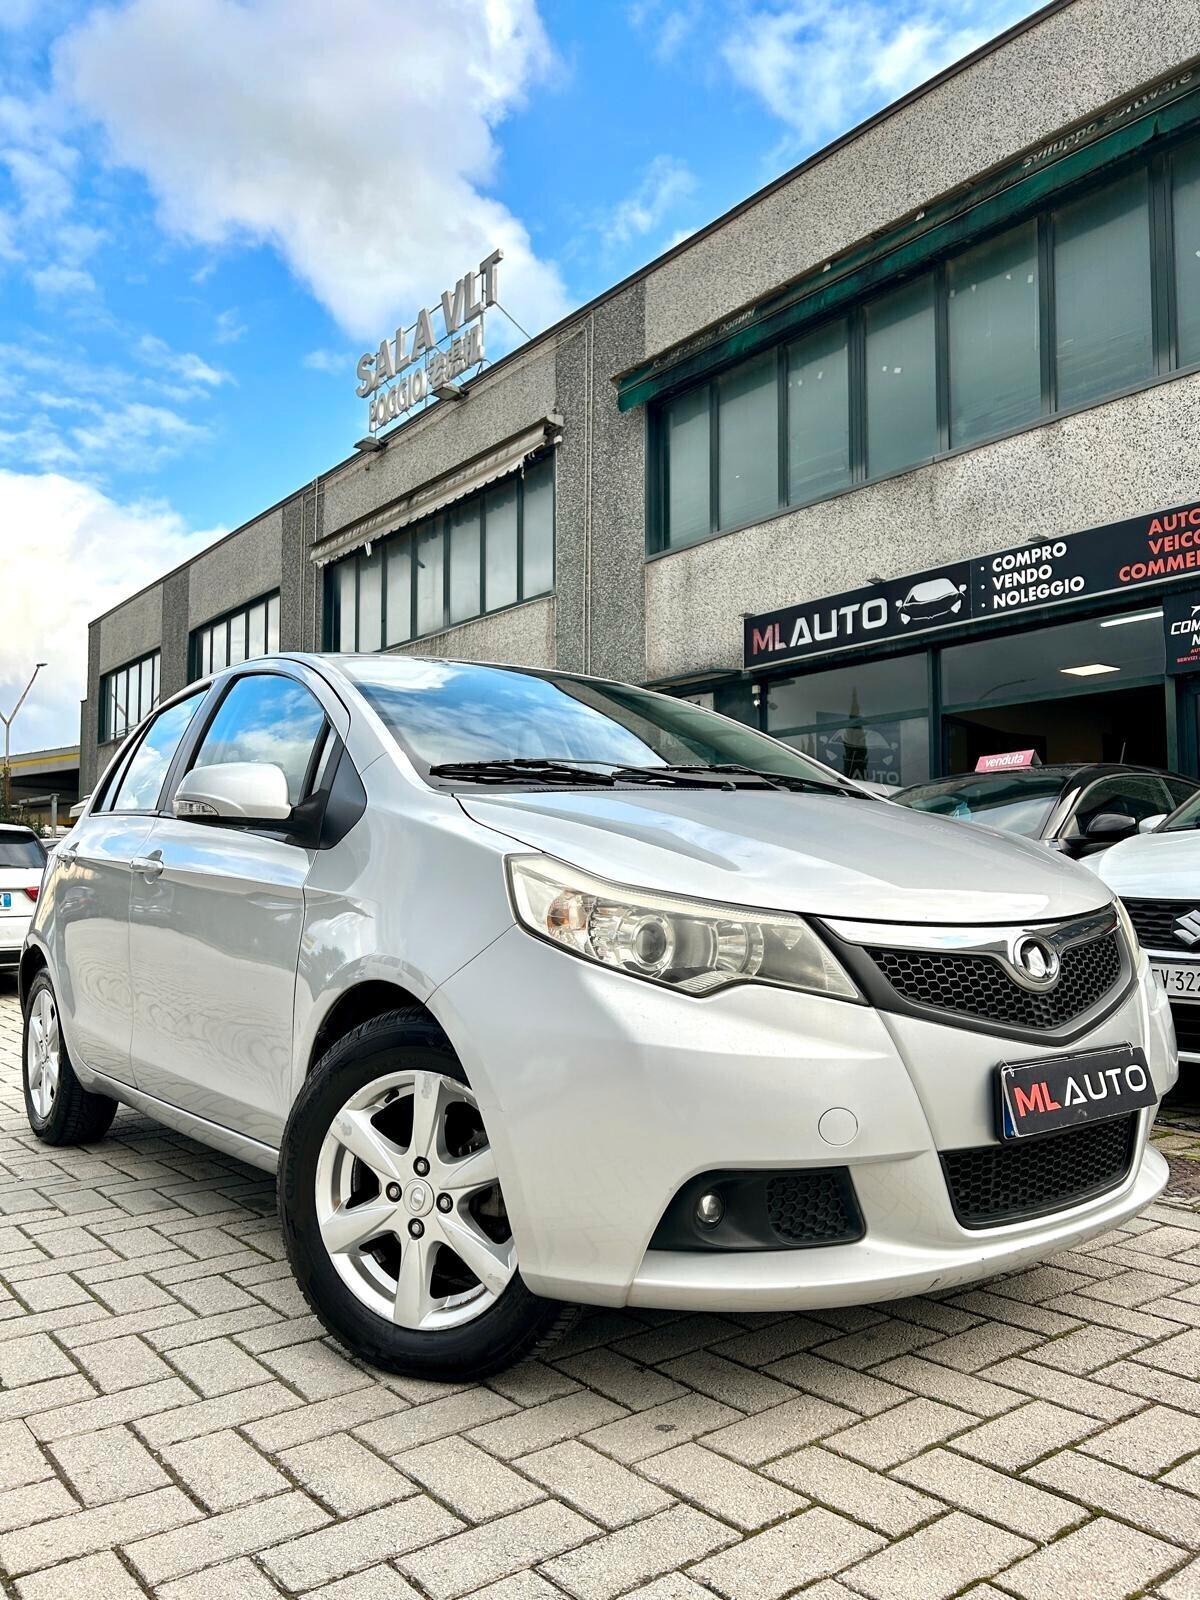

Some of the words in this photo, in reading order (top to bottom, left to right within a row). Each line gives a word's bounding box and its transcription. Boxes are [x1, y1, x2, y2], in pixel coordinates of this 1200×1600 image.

[356, 309, 435, 398] SALA
[441, 248, 504, 337] VLT
[369, 367, 427, 433] POGGIO
[992, 541, 1067, 573] COMPRO
[1119, 550, 1200, 582] COMME
[992, 564, 1053, 591] VENDO
[993, 576, 1085, 609] NOLEGGIO
[985, 753, 1024, 768] venduta
